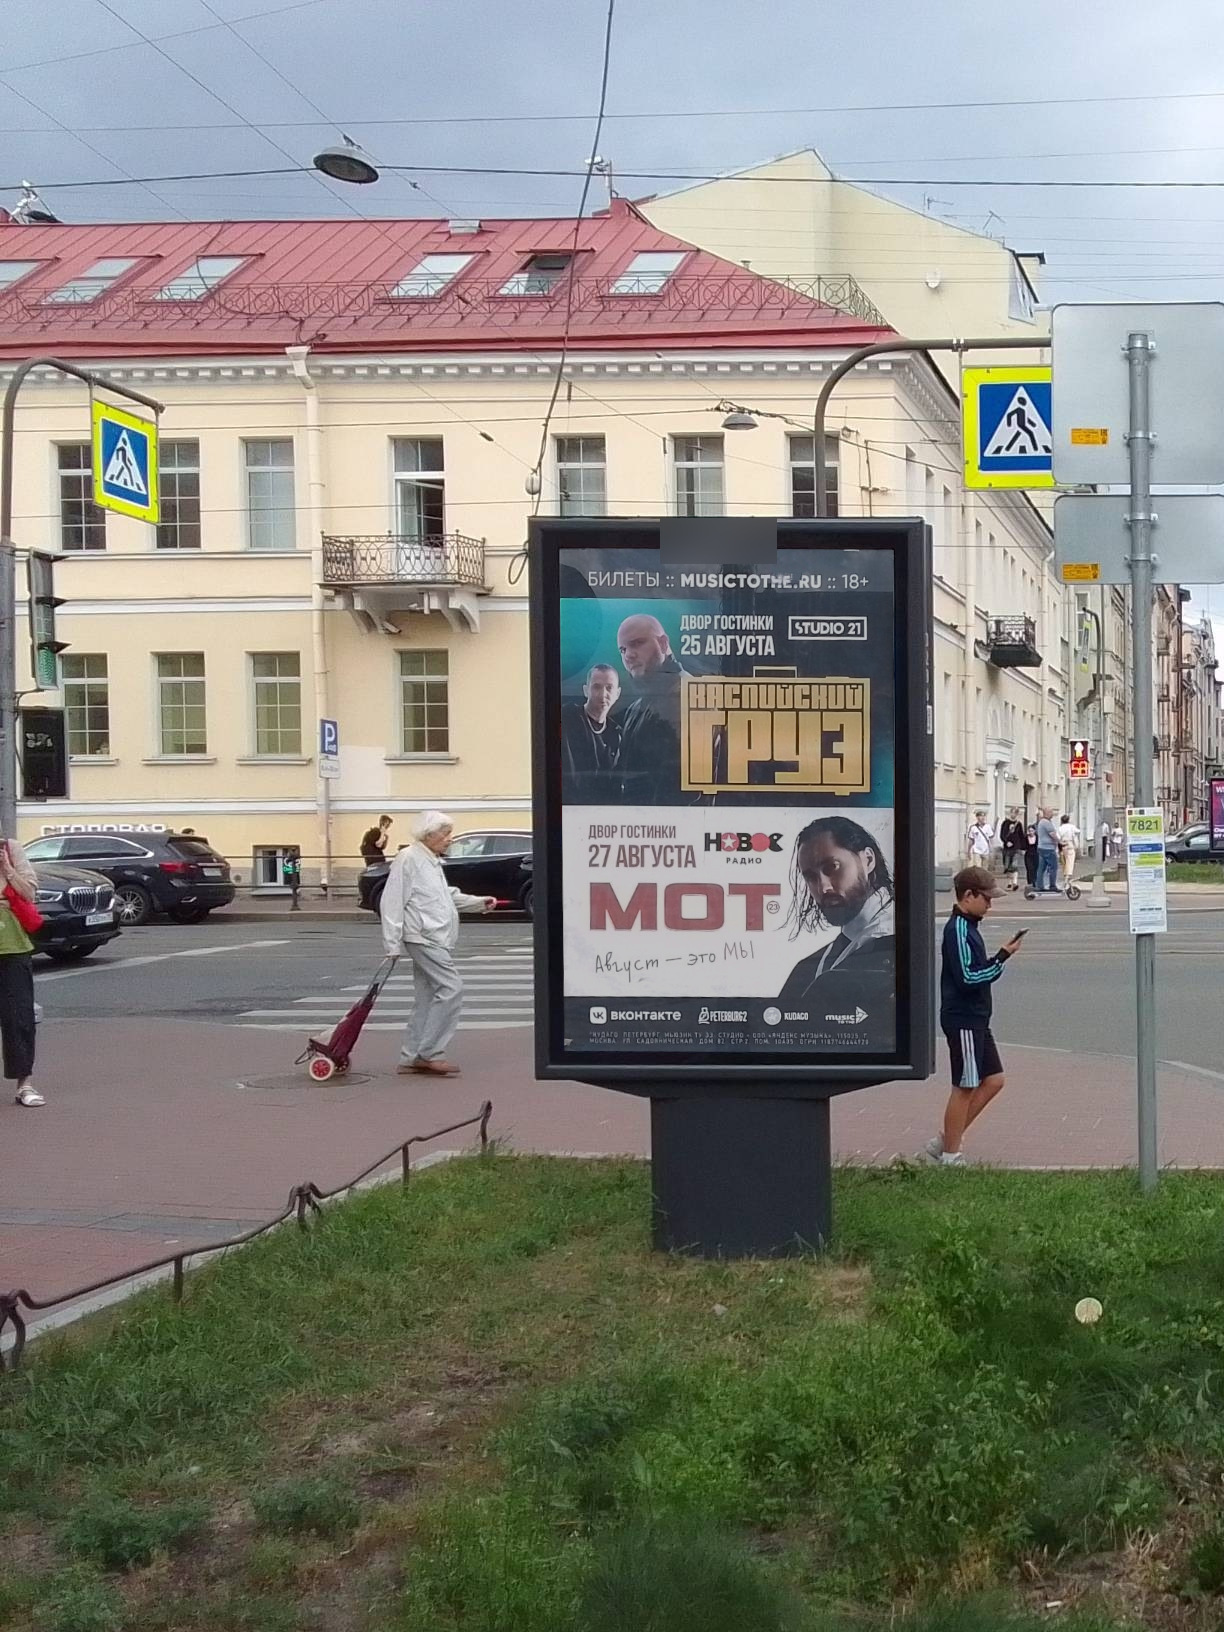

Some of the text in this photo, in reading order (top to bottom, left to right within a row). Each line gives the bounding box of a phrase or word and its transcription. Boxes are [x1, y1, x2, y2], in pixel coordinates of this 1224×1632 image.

[588, 571, 660, 588] БИЛЕТЫ
[680, 573, 822, 589] MUSICTOTHE.RU
[841, 573, 869, 590] 18+
[680, 614, 774, 632] ДВОР ГОСТИНКИ
[794, 622, 861, 635] STUDIO 21
[680, 635, 776, 656] 25 АВГУСТА
[688, 711, 863, 785] ГРУЗ
[588, 825, 676, 839] ДВОР ГОСТИНКИ
[1129, 819, 1159, 831] 7821
[588, 844, 697, 868] 27 АВГУСТА
[726, 857, 762, 865] РАДИО
[589, 882, 781, 931] МОТ
[595, 951, 659, 983] Август
[687, 953, 716, 966] это
[723, 940, 755, 961] МЫ
